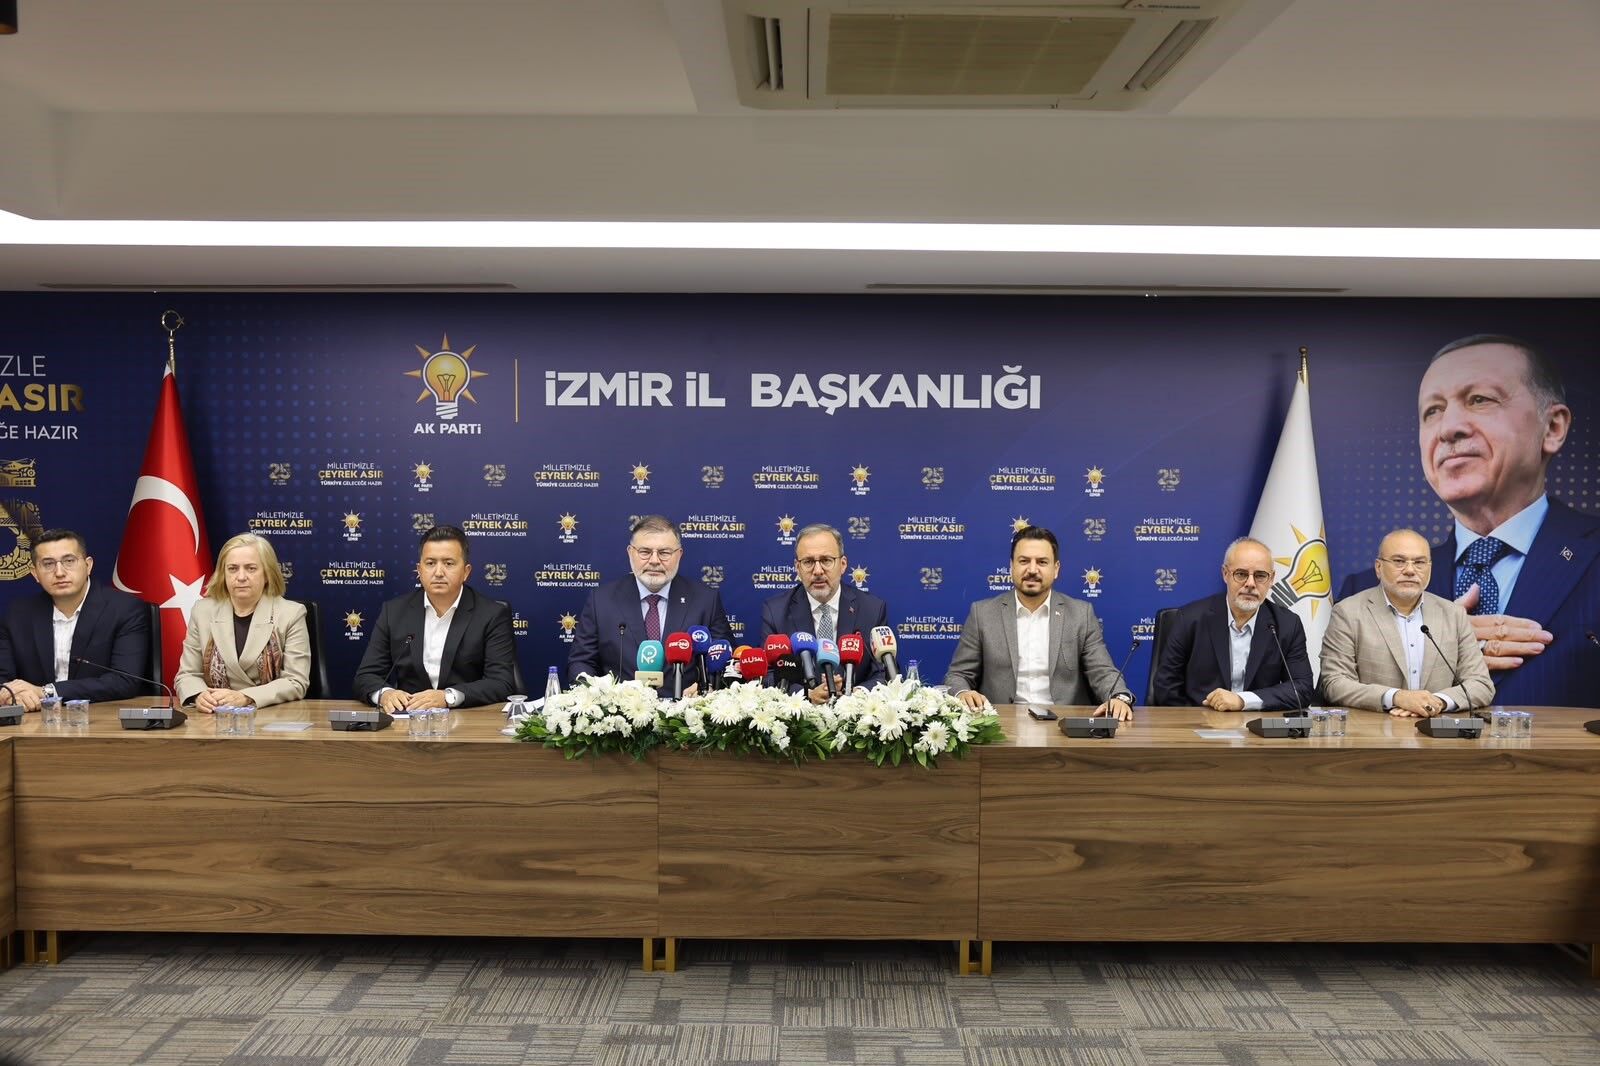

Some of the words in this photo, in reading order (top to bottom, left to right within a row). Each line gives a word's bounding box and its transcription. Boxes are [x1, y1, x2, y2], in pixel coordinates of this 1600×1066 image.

[545, 370, 674, 406] İZMİR
[686, 372, 726, 406] İL
[751, 365, 1040, 416] BAŞKANLIĞI
[0, 383, 86, 412] ASIR
[25, 425, 78, 440] HAZIR
[414, 422, 435, 434] AK
[440, 422, 482, 434] PARTİ
[327, 462, 374, 470] MİLLETİMİZLE
[543, 464, 591, 472] MİLLETİMİZLE
[998, 467, 1047, 475] MİLLETİMİZLE
[318, 470, 358, 481] ÇEYREK
[360, 470, 383, 479] ASIR
[534, 472, 574, 482] ÇEYREK
[576, 472, 599, 481] ASIR
[752, 474, 794, 484] ÇEYREK
[795, 474, 819, 483] ASIR
[989, 476, 1030, 486] ÇEYREK
[1032, 476, 1056, 485] ASIR
[471, 513, 519, 521] MİLLETİMİZLE
[908, 516, 956, 524] MİLLETİMİZLE
[248, 520, 288, 530] ÇEYREK
[290, 520, 313, 528] ASIR
[462, 521, 503, 531] ÇEYREK
[504, 521, 528, 530] ASIR
[679, 523, 720, 533] ÇEYREK
[721, 523, 745, 532] ASIR
[899, 525, 939, 535] ÇEYREK
[941, 525, 964, 534] ASIR
[1134, 526, 1175, 536] ÇEYREK
[1176, 526, 1200, 535] ASIR
[543, 563, 591, 571] MİLLETİMİZLE
[320, 570, 360, 580] ÇEYREK
[362, 570, 385, 578] ASIR
[534, 572, 575, 582] ÇEYREK
[577, 572, 600, 581] ASIR
[752, 574, 793, 584] ÇEYREK
[988, 575, 1013, 585] ÇEYR
[512, 620, 528, 628] SIR
[905, 616, 954, 624] MİLLETİMİZLE
[729, 622, 745, 630] SIR
[897, 625, 937, 635] ÇEYREK
